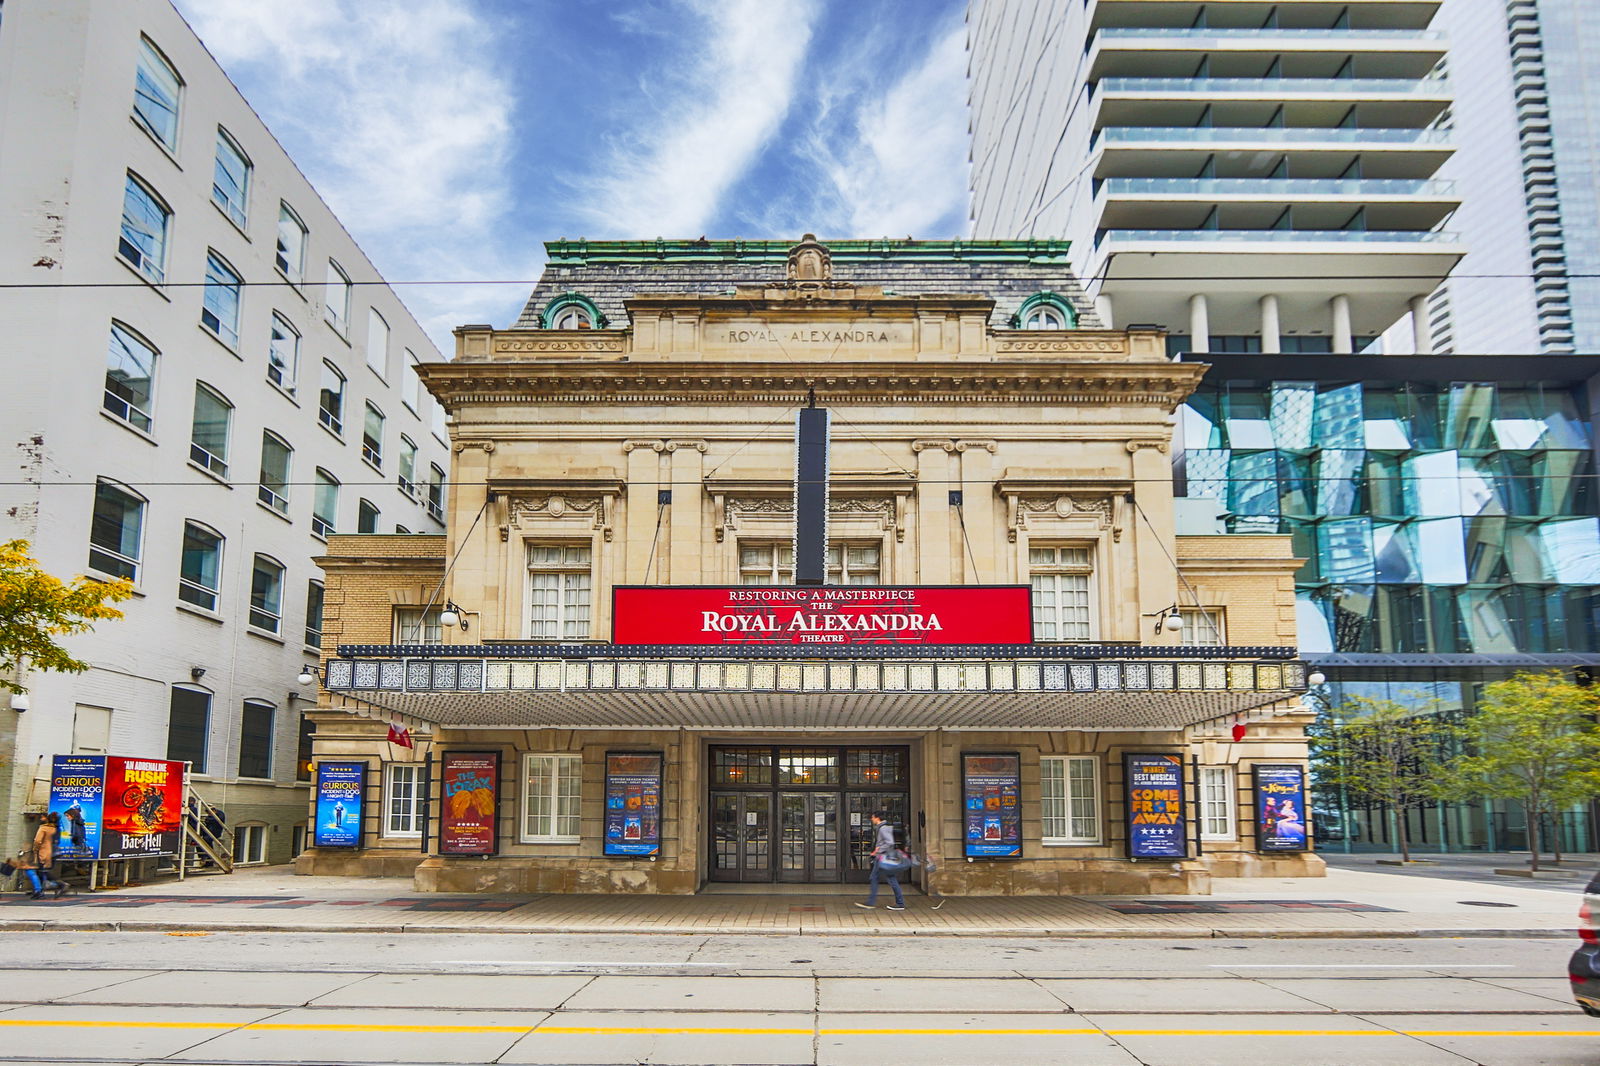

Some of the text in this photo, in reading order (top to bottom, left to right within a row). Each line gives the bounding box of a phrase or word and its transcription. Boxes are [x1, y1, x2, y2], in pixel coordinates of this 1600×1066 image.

[728, 331, 889, 343] ROYAL ALEXANDRA
[729, 590, 916, 601] RESTORING A MASTERPIECE
[810, 602, 833, 610] THE
[701, 610, 943, 632] ROYAL ALEXANDRA
[800, 634, 845, 643] THEATRE
[456, 771, 476, 781] THE
[1133, 773, 1149, 781] BEST
[54, 777, 101, 787] CURIOUS
[322, 782, 360, 790] CURIOUS
[445, 776, 493, 798] LORAX
[1131, 789, 1180, 801] COME
[1131, 812, 1180, 825] AWAY
[144, 833, 162, 851] Hell
